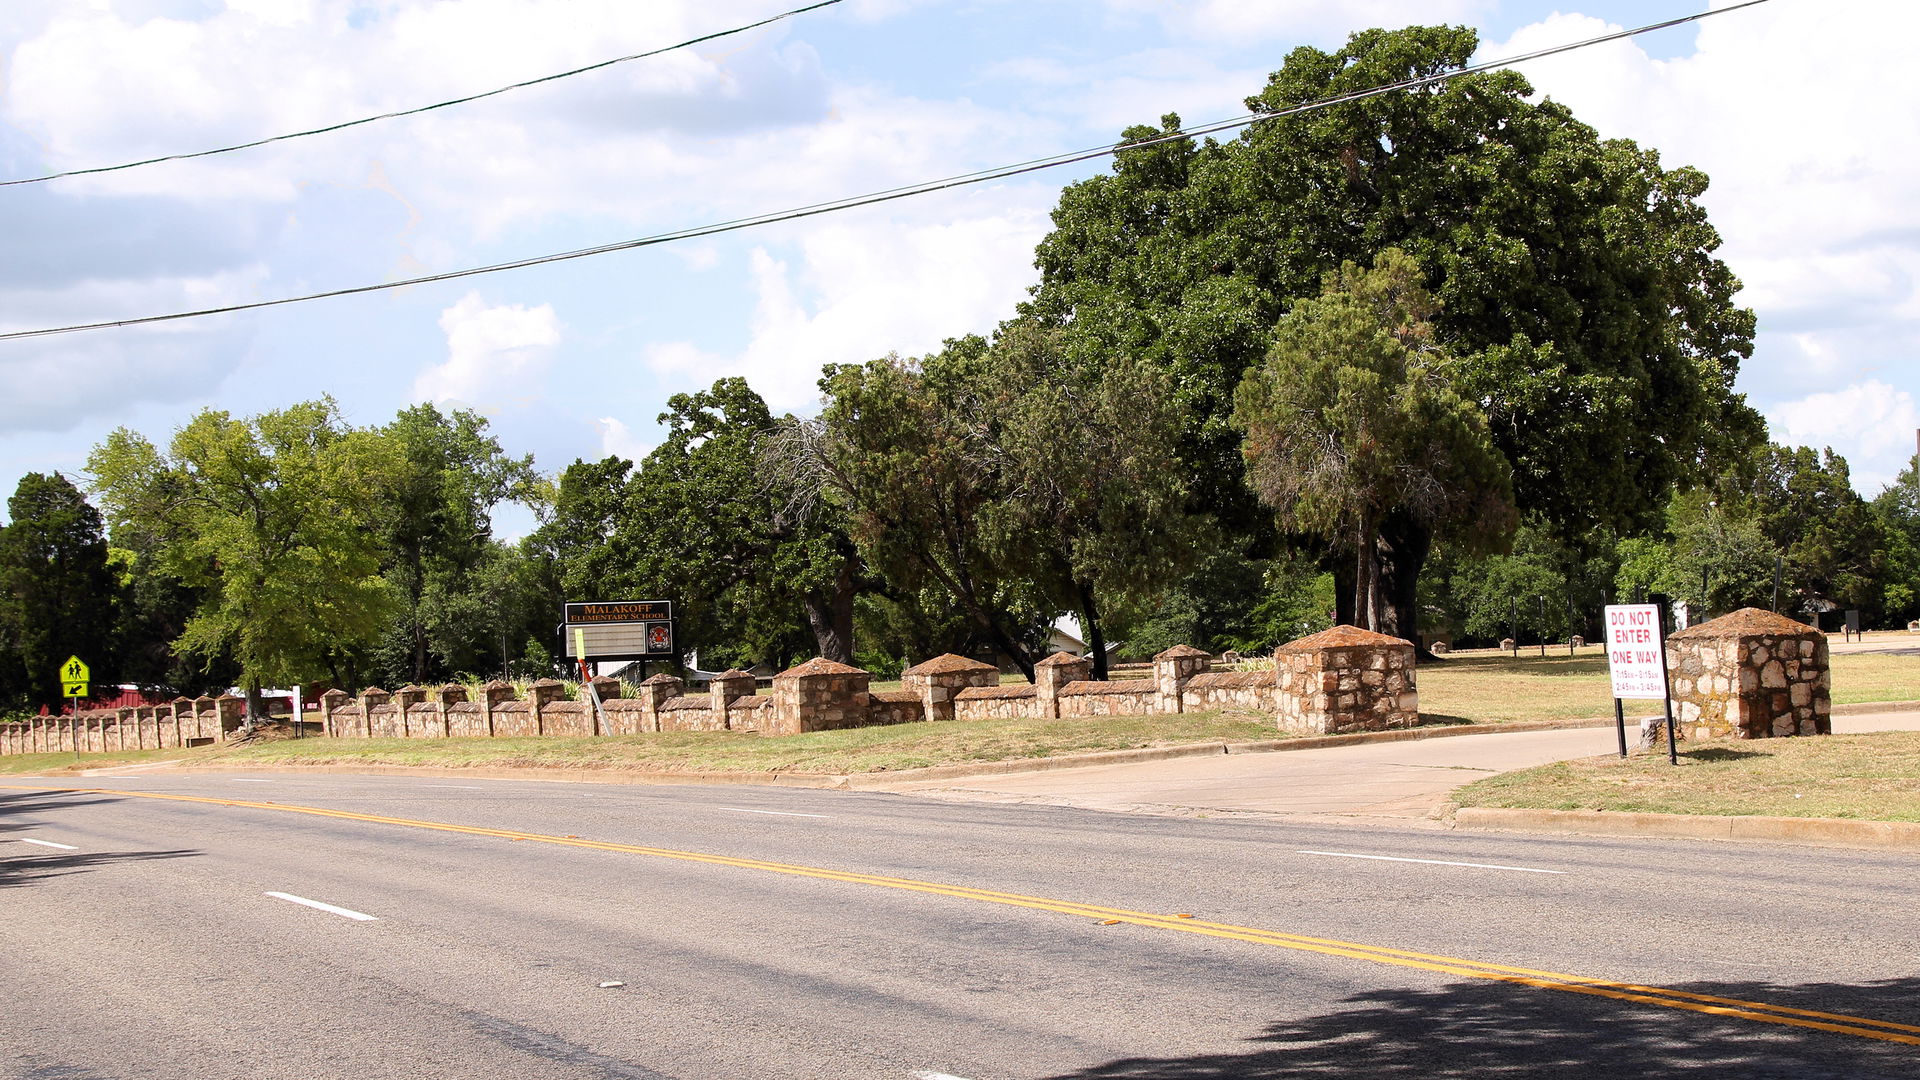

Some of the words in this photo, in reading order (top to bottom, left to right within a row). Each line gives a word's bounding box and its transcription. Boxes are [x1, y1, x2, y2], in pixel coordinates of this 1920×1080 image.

[584, 604, 653, 615] MALAKOFF
[571, 614, 629, 622] ELEMENTARY
[1611, 612, 1625, 625] DO
[1629, 611, 1651, 625] NOT
[1615, 629, 1651, 643] ENTER
[1613, 651, 1632, 664] ONE
[1636, 651, 1657, 664] WAY
